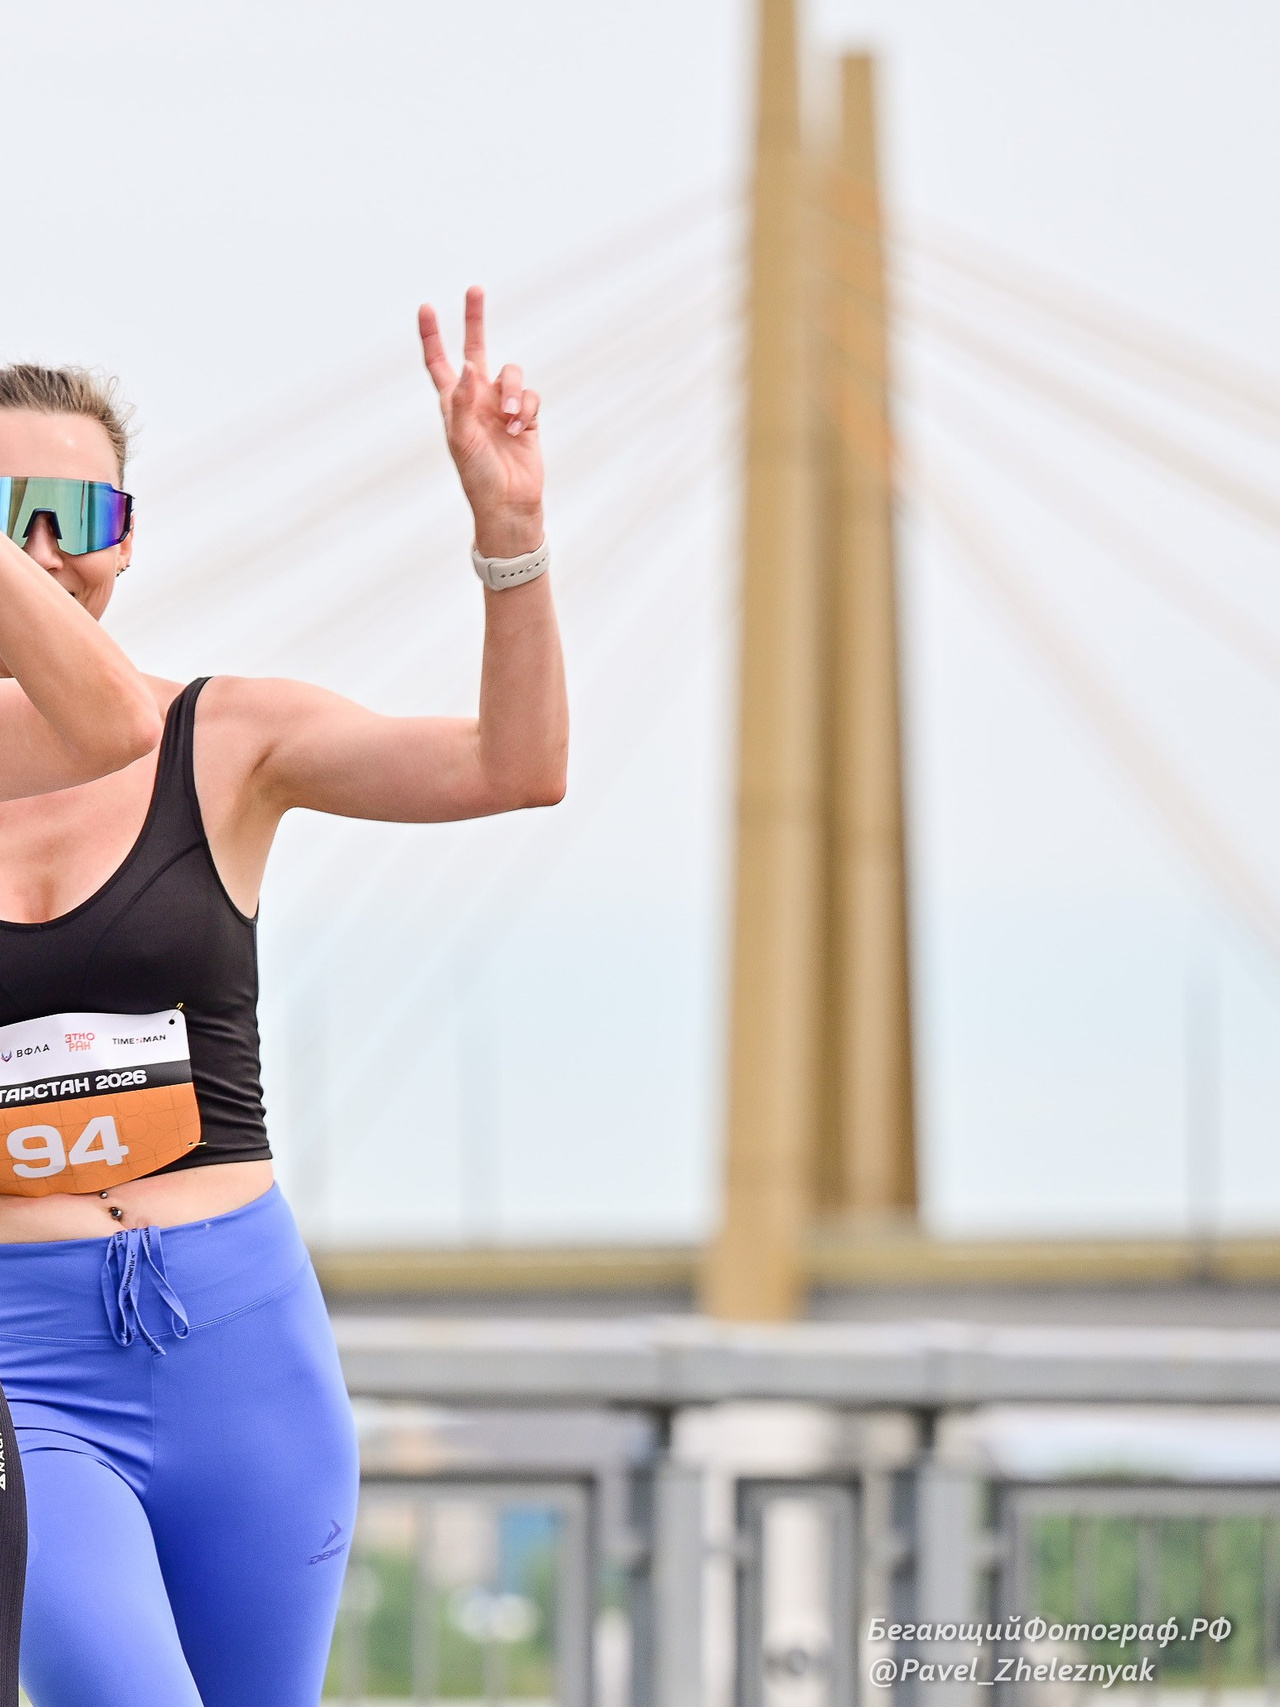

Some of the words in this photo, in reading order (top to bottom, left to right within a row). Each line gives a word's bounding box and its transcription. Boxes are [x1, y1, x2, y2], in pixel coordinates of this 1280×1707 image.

[16, 1043, 50, 1058] ВФЛА
[95, 1069, 147, 1090] 2026
[6, 1115, 130, 1178] 94
